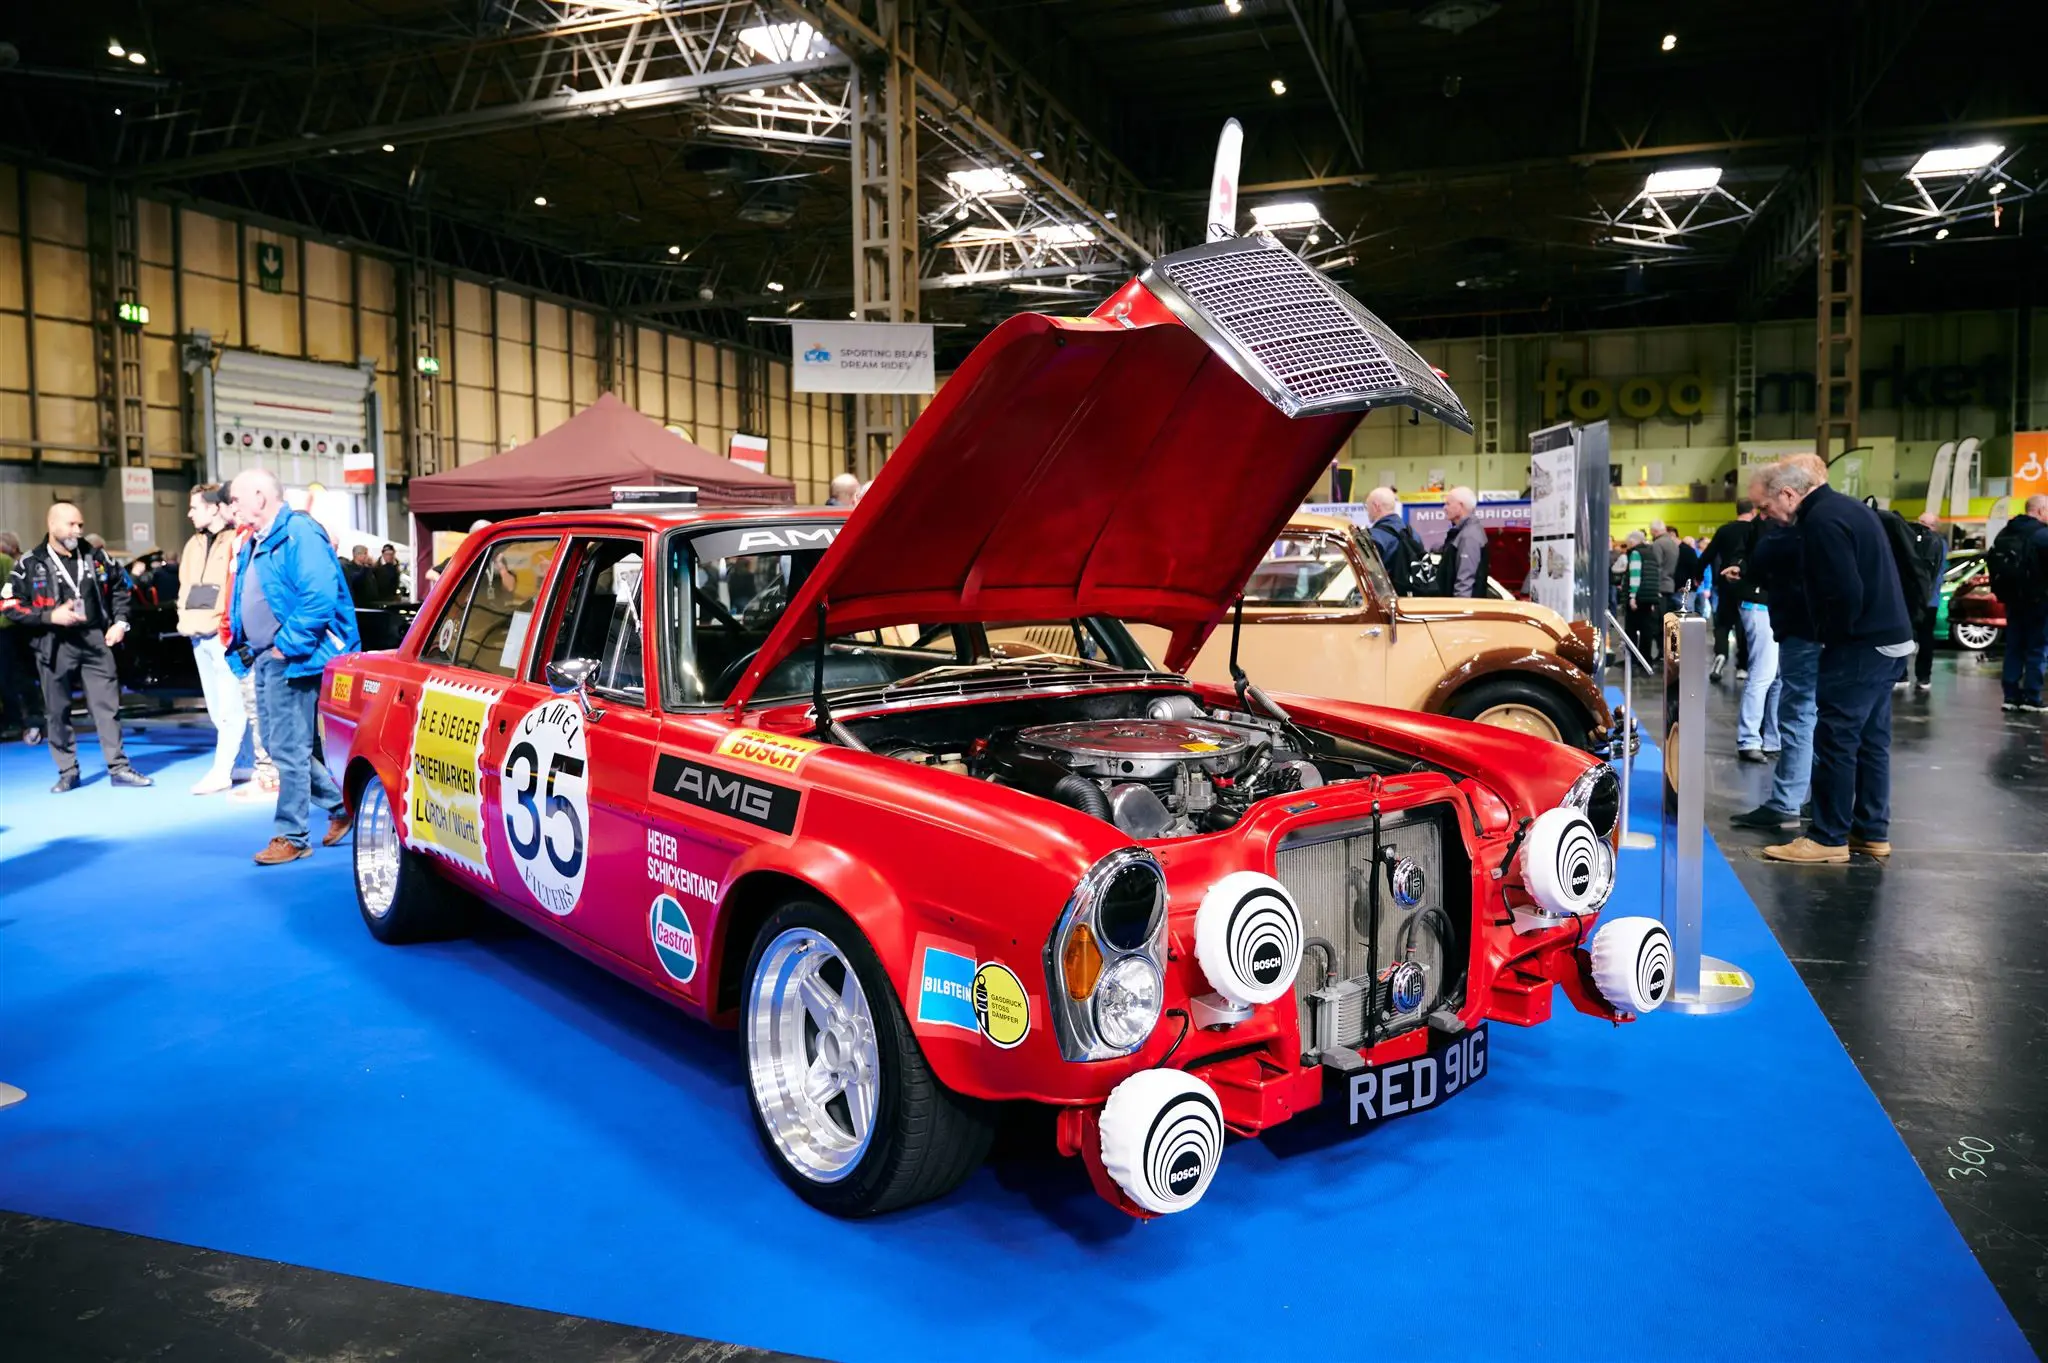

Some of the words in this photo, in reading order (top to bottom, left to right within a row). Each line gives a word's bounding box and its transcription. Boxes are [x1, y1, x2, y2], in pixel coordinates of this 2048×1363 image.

[840, 349, 891, 358] SPORTING
[894, 350, 928, 359] BEARS
[840, 361, 877, 369] DREAM
[1534, 356, 1712, 420] food
[1756, 345, 2012, 413] mrket
[739, 528, 842, 551] AM
[438, 712, 480, 746] SIEGER
[731, 735, 807, 769] BOSCH
[415, 753, 476, 796] BRIEFMARKEN
[505, 741, 585, 878] 35
[673, 766, 773, 820] AMG
[648, 828, 678, 862] HEYER
[524, 865, 575, 911] FILTERS
[647, 856, 719, 905] SCHICKENTANZ
[657, 923, 693, 956] Castrol
[1253, 956, 1281, 971] BOSCH
[923, 976, 972, 1002] BILSTEIN
[991, 993, 1022, 1008] GASDRUCK
[991, 1002, 1010, 1013] STOSS
[1350, 1057, 1438, 1126] RED
[1445, 1030, 1485, 1094] 91G
[1170, 1165, 1200, 1184] BOSCH
[1947, 1136, 1995, 1180] 360
